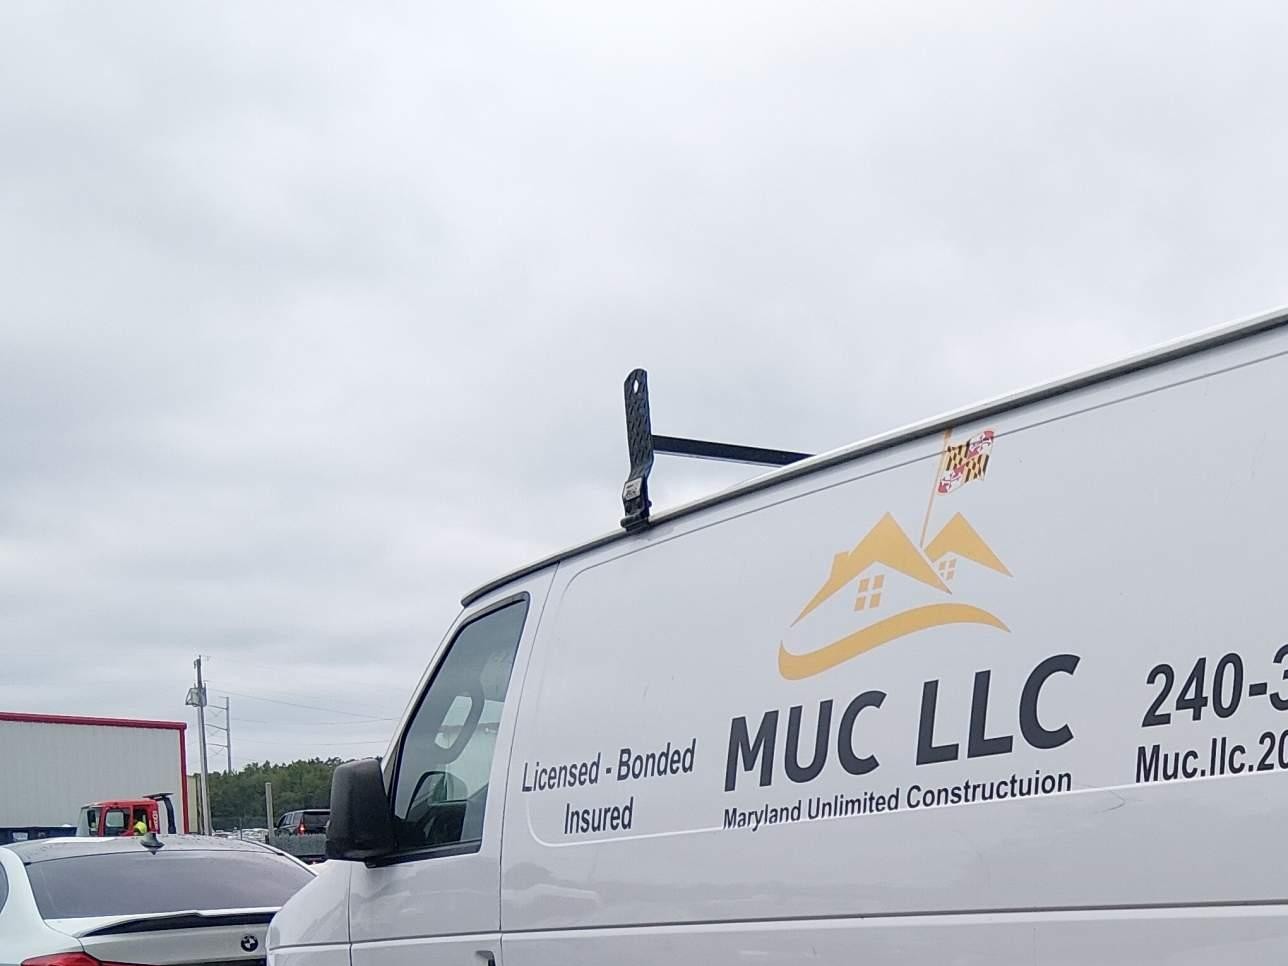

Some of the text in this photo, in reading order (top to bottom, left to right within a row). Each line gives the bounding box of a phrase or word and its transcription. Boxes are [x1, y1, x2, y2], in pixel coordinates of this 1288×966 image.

[724, 653, 1081, 793] MUC LLC
[521, 752, 601, 793] Licensed
[616, 737, 697, 782] Bonded
[564, 796, 634, 835] Insured
[723, 769, 1072, 833] Maryland Unlimited Constructuion
